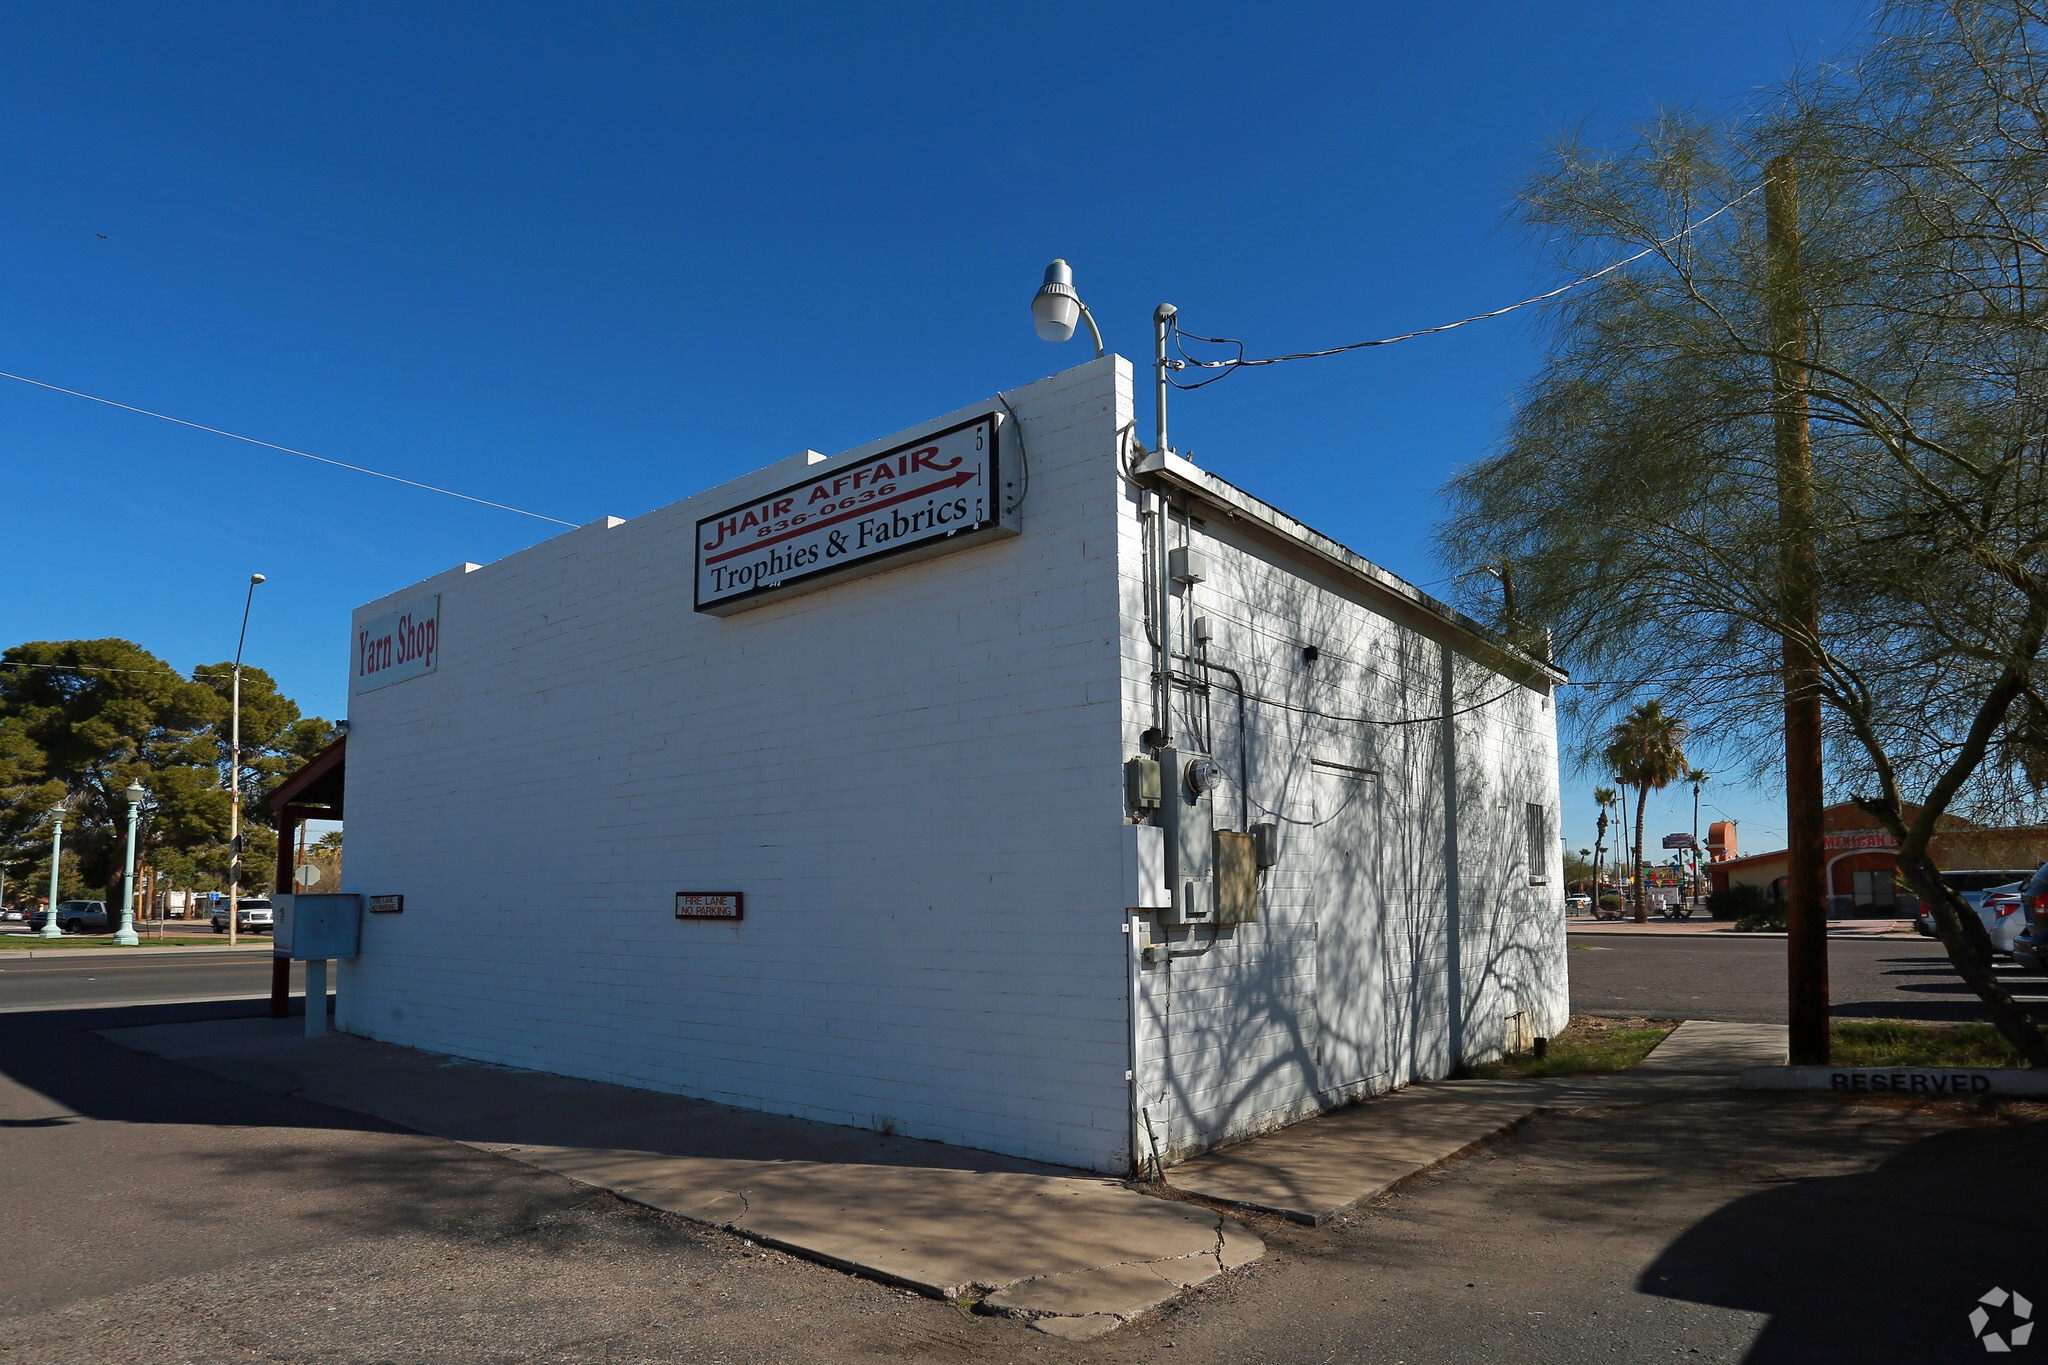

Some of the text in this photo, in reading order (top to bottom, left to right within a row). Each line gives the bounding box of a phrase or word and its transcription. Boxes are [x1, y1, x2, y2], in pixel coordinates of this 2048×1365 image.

[703, 446, 963, 551] HAIR AFFAIR
[756, 482, 897, 538] 836-0636
[710, 497, 967, 592] Trophies & Fabrics
[359, 612, 436, 677] Yarn Shop
[1824, 835, 1885, 849] MEXICAN
[682, 906, 732, 915] NO PARKING
[685, 897, 727, 906] FIRE LANE
[1831, 1073, 1991, 1093] RESERVED
